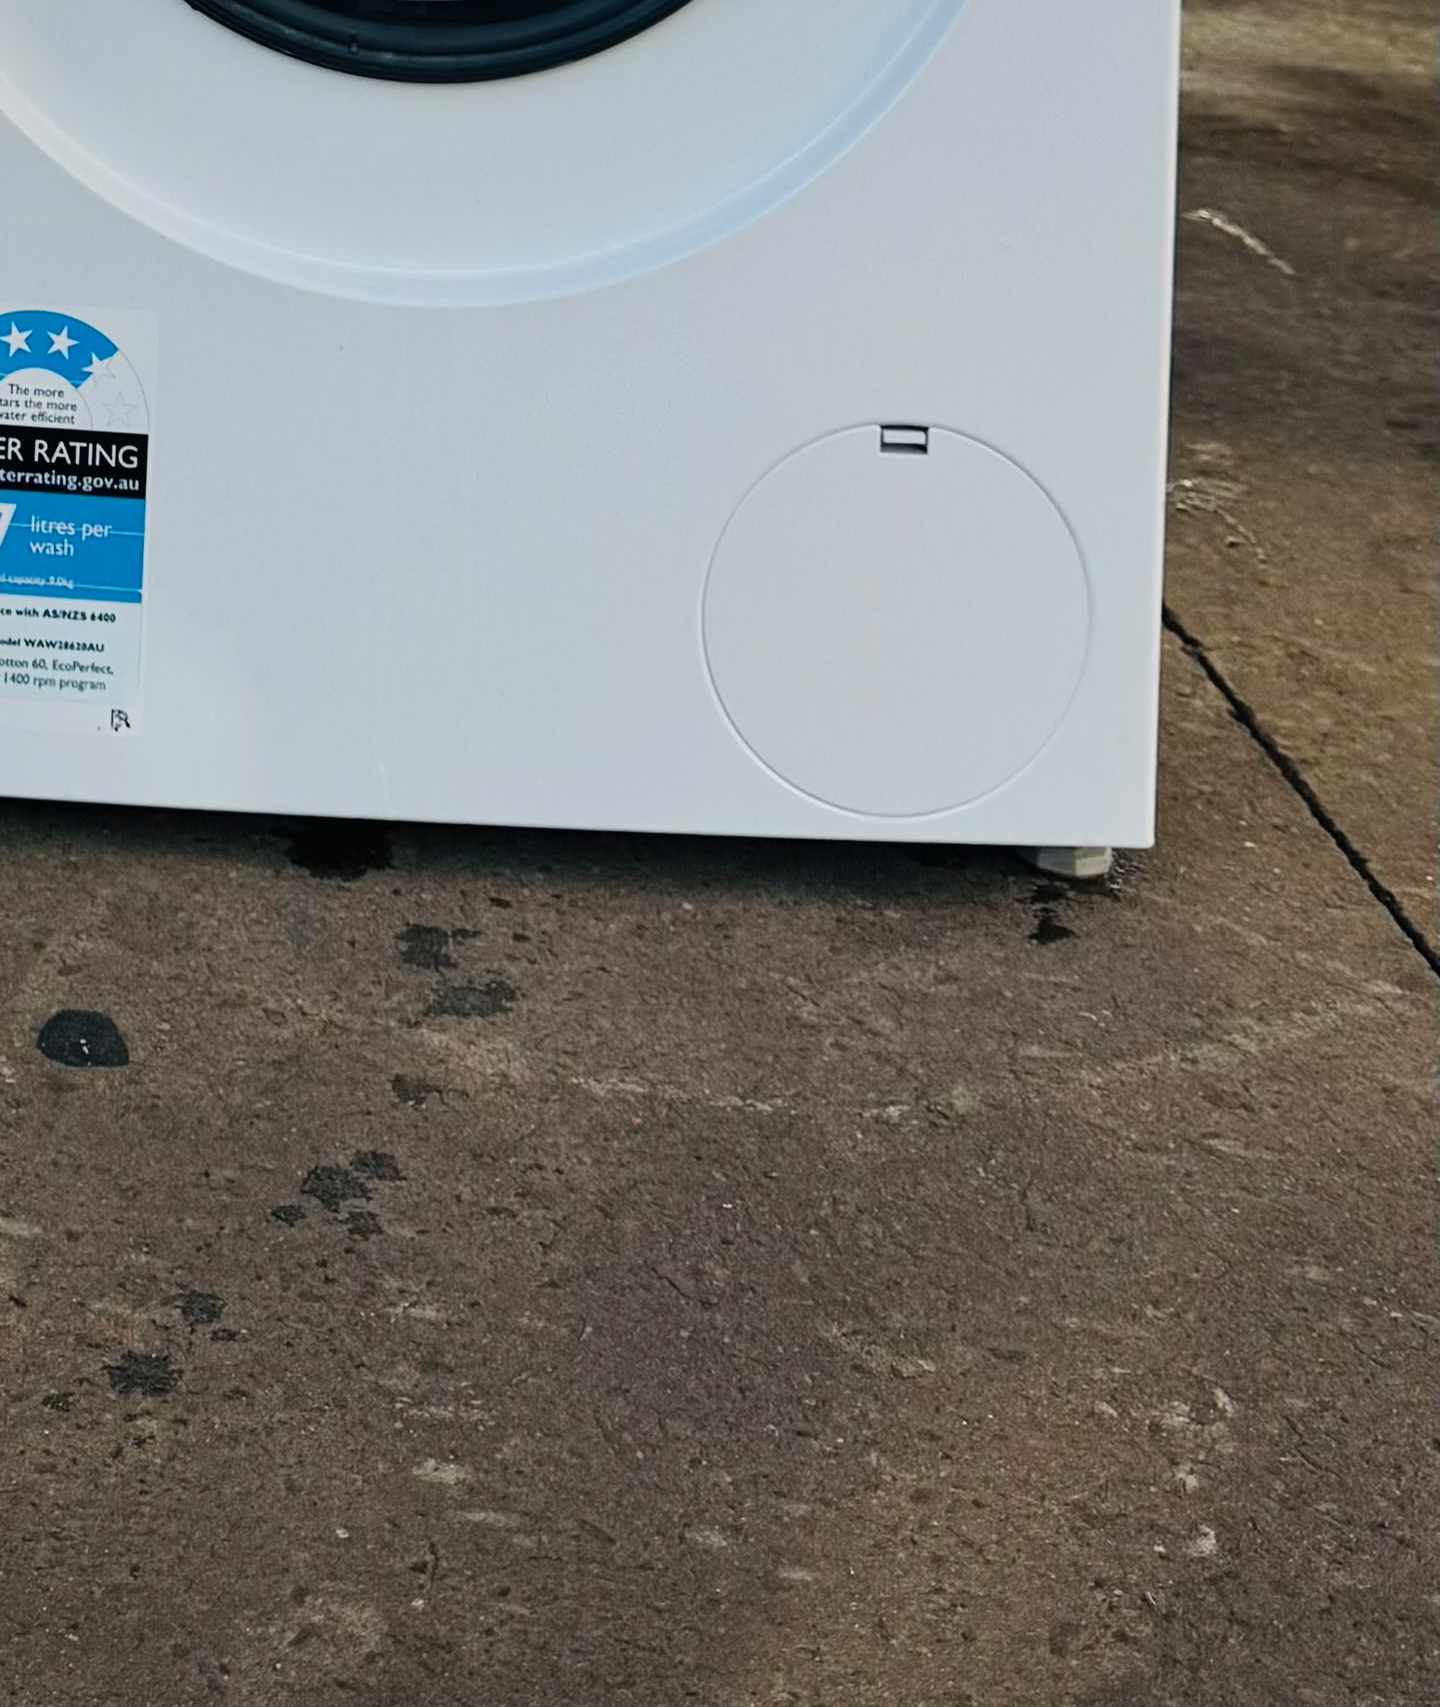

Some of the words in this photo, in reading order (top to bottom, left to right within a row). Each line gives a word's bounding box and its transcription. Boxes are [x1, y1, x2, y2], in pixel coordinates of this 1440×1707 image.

[9, 383, 30, 396] The
[33, 388, 64, 398] more
[24, 398, 42, 410] the
[46, 401, 77, 412] more
[31, 411, 75, 425] efficient
[34, 439, 139, 469] RATING
[30, 515, 75, 536] litres
[81, 523, 112, 542] per
[29, 538, 74, 557] wash
[15, 607, 39, 618] with
[90, 612, 116, 623] 6400
[52, 660, 114, 675] EcoPerfect,
[4, 672, 30, 684] 1400
[33, 677, 56, 689] rpm
[60, 678, 106, 692] program
